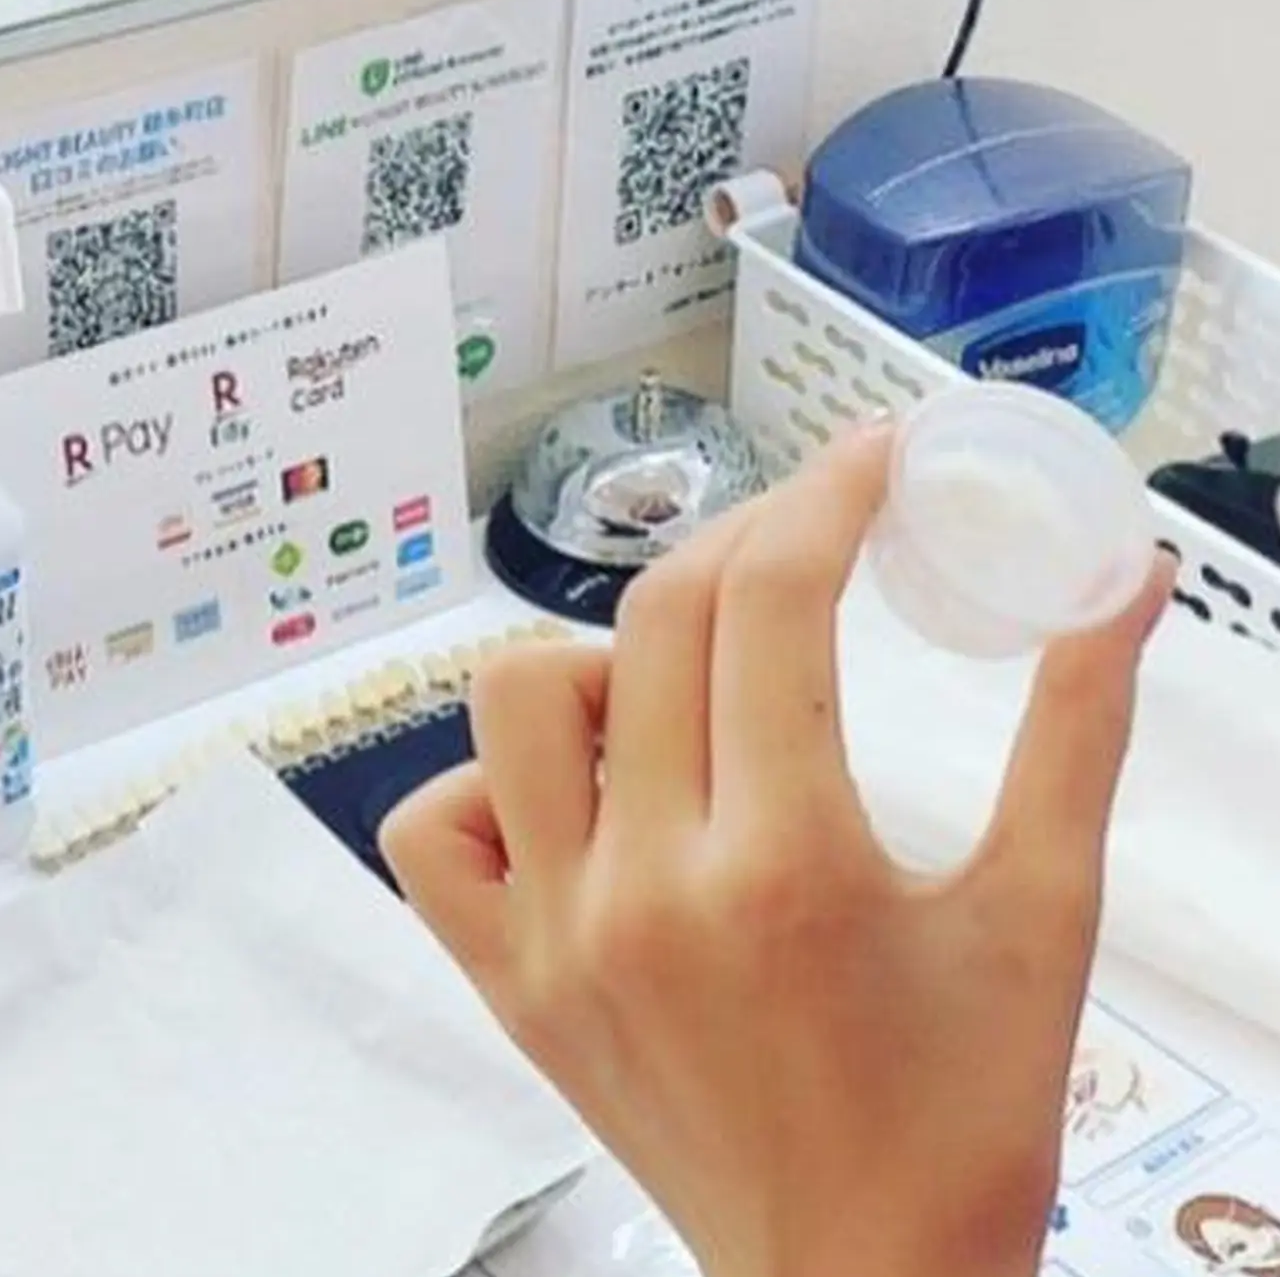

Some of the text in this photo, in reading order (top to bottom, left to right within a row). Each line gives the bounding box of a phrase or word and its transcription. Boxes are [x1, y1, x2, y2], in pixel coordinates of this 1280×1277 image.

[57, 120, 137, 158] BEAUTY
[287, 335, 380, 383] Rakuten
[291, 378, 345, 413] Card
[101, 414, 173, 464] Pay
